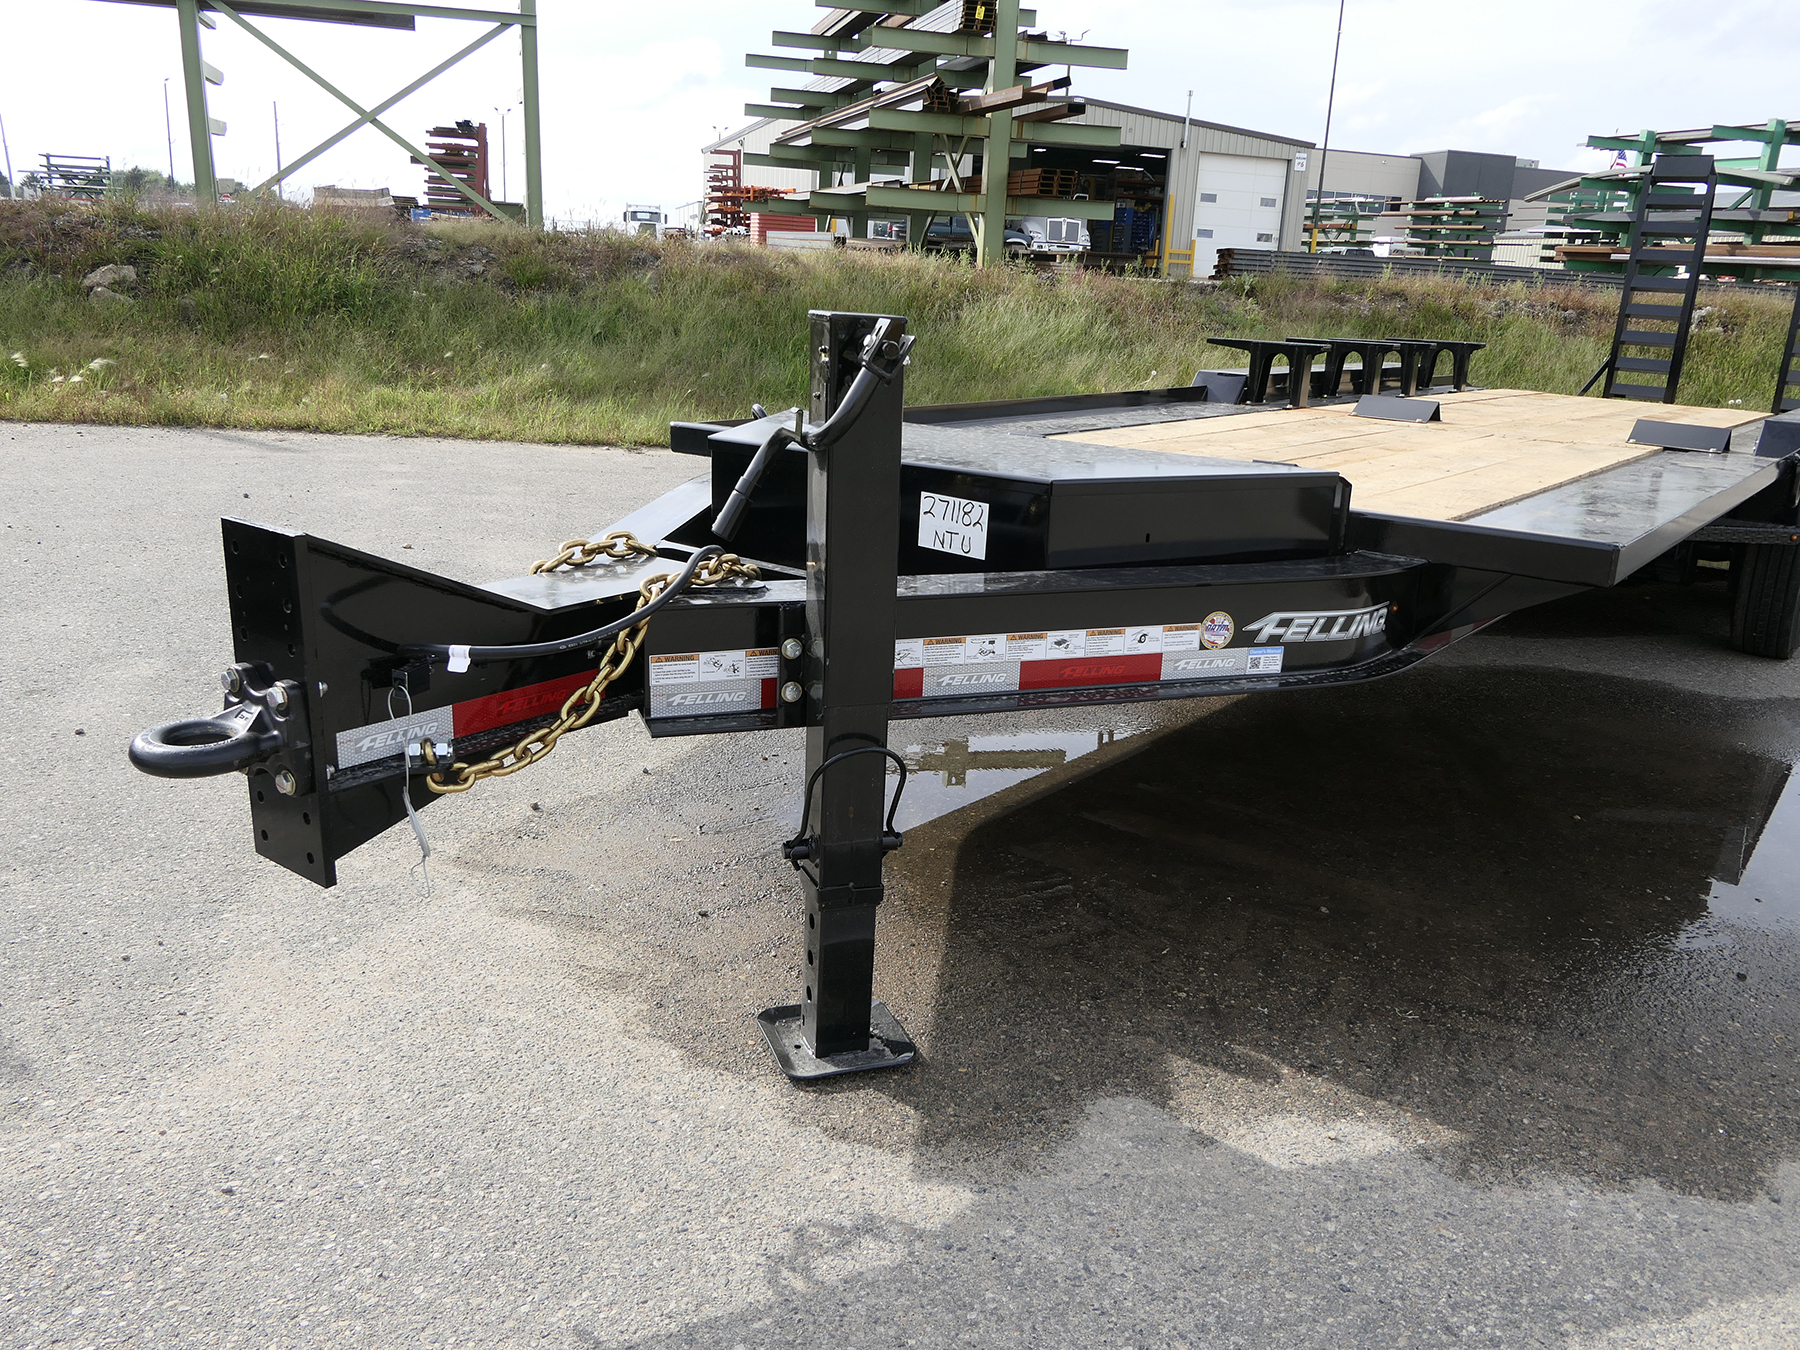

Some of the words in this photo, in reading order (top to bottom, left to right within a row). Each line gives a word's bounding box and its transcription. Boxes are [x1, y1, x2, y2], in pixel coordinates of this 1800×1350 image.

[923, 496, 983, 532] 271182
[933, 530, 971, 554] NTU
[1242, 601, 1389, 643] FELLING
[664, 654, 695, 662] WARNING
[1173, 656, 1236, 671] FELLING
[937, 670, 1007, 687] FELLING
[1060, 664, 1126, 678] FELLING
[498, 688, 568, 715] FELLING
[667, 689, 748, 706] FELLING
[355, 721, 439, 752] FELLING
